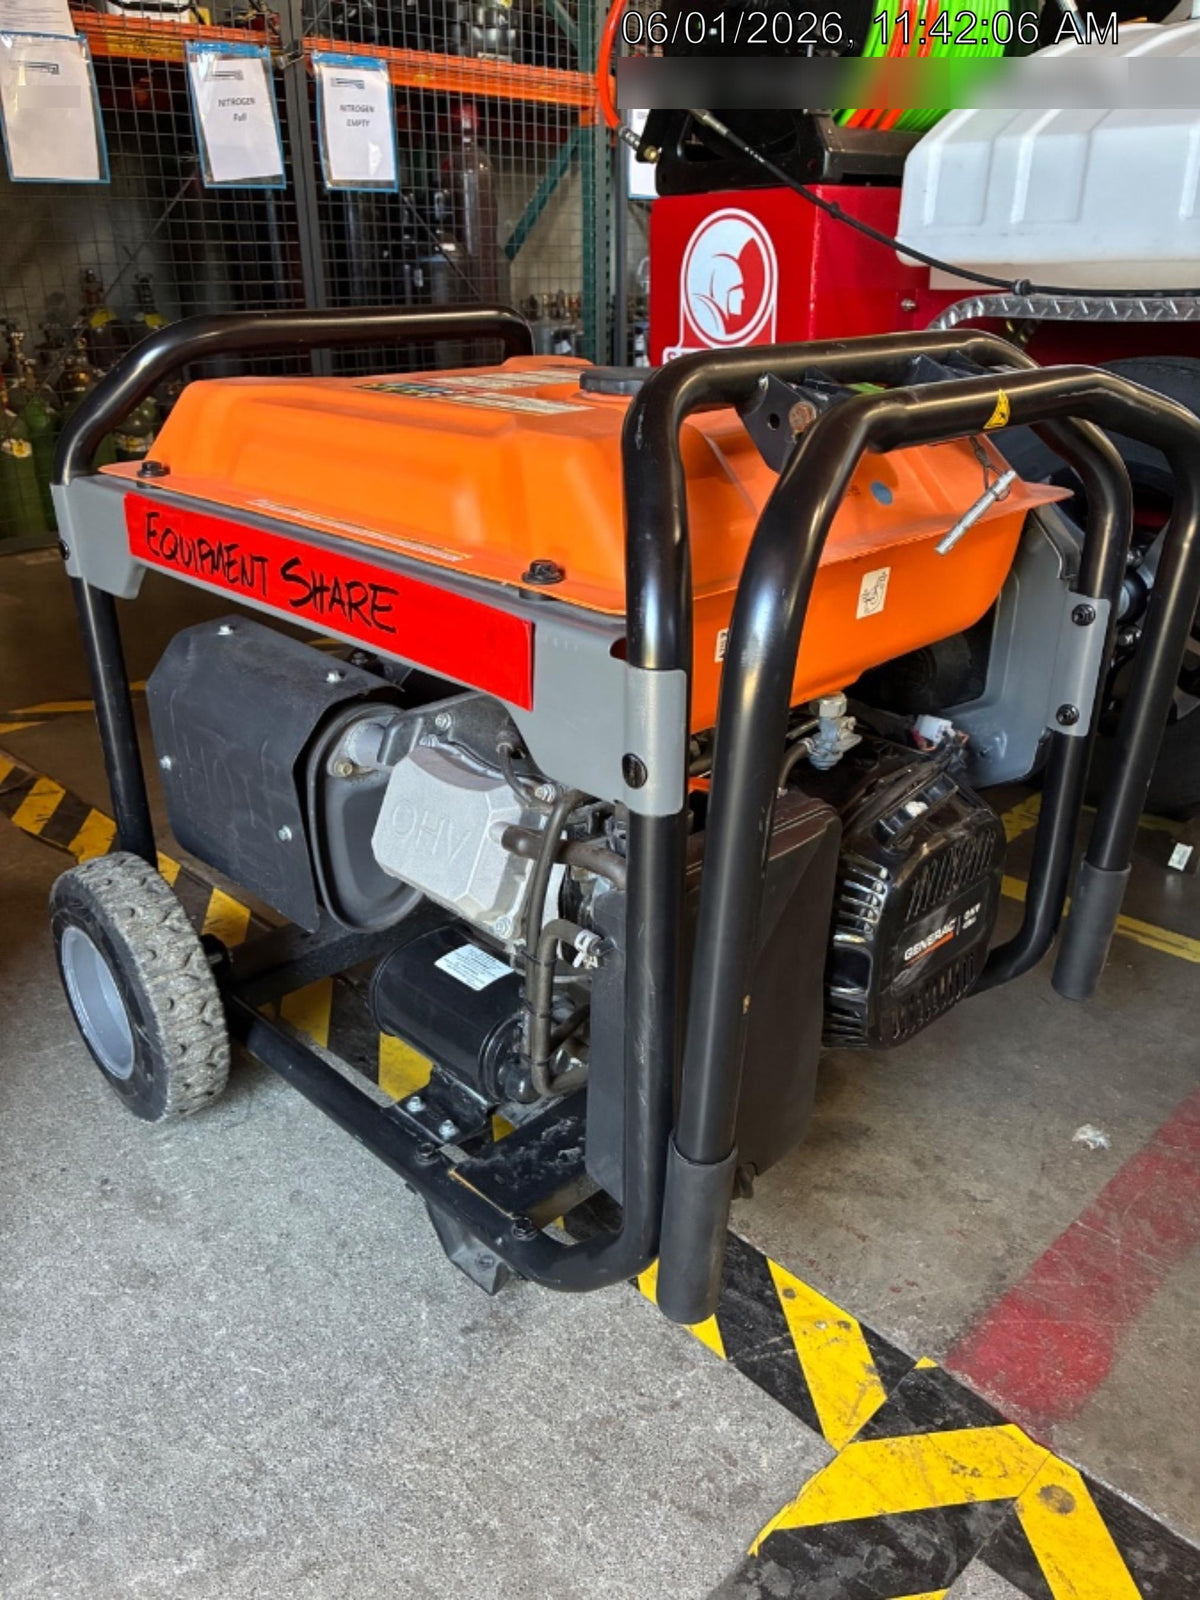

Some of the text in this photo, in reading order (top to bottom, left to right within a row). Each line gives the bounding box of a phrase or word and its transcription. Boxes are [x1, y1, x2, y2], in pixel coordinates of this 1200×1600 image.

[217, 97, 256, 107] NITROGEN
[339, 104, 375, 112] NITROGEN
[346, 119, 371, 127] EMPTY
[145, 511, 269, 597] EQUIPMENT
[279, 556, 400, 634] SHARE
[390, 799, 474, 865] OHV
[904, 916, 957, 961] GENERAC
